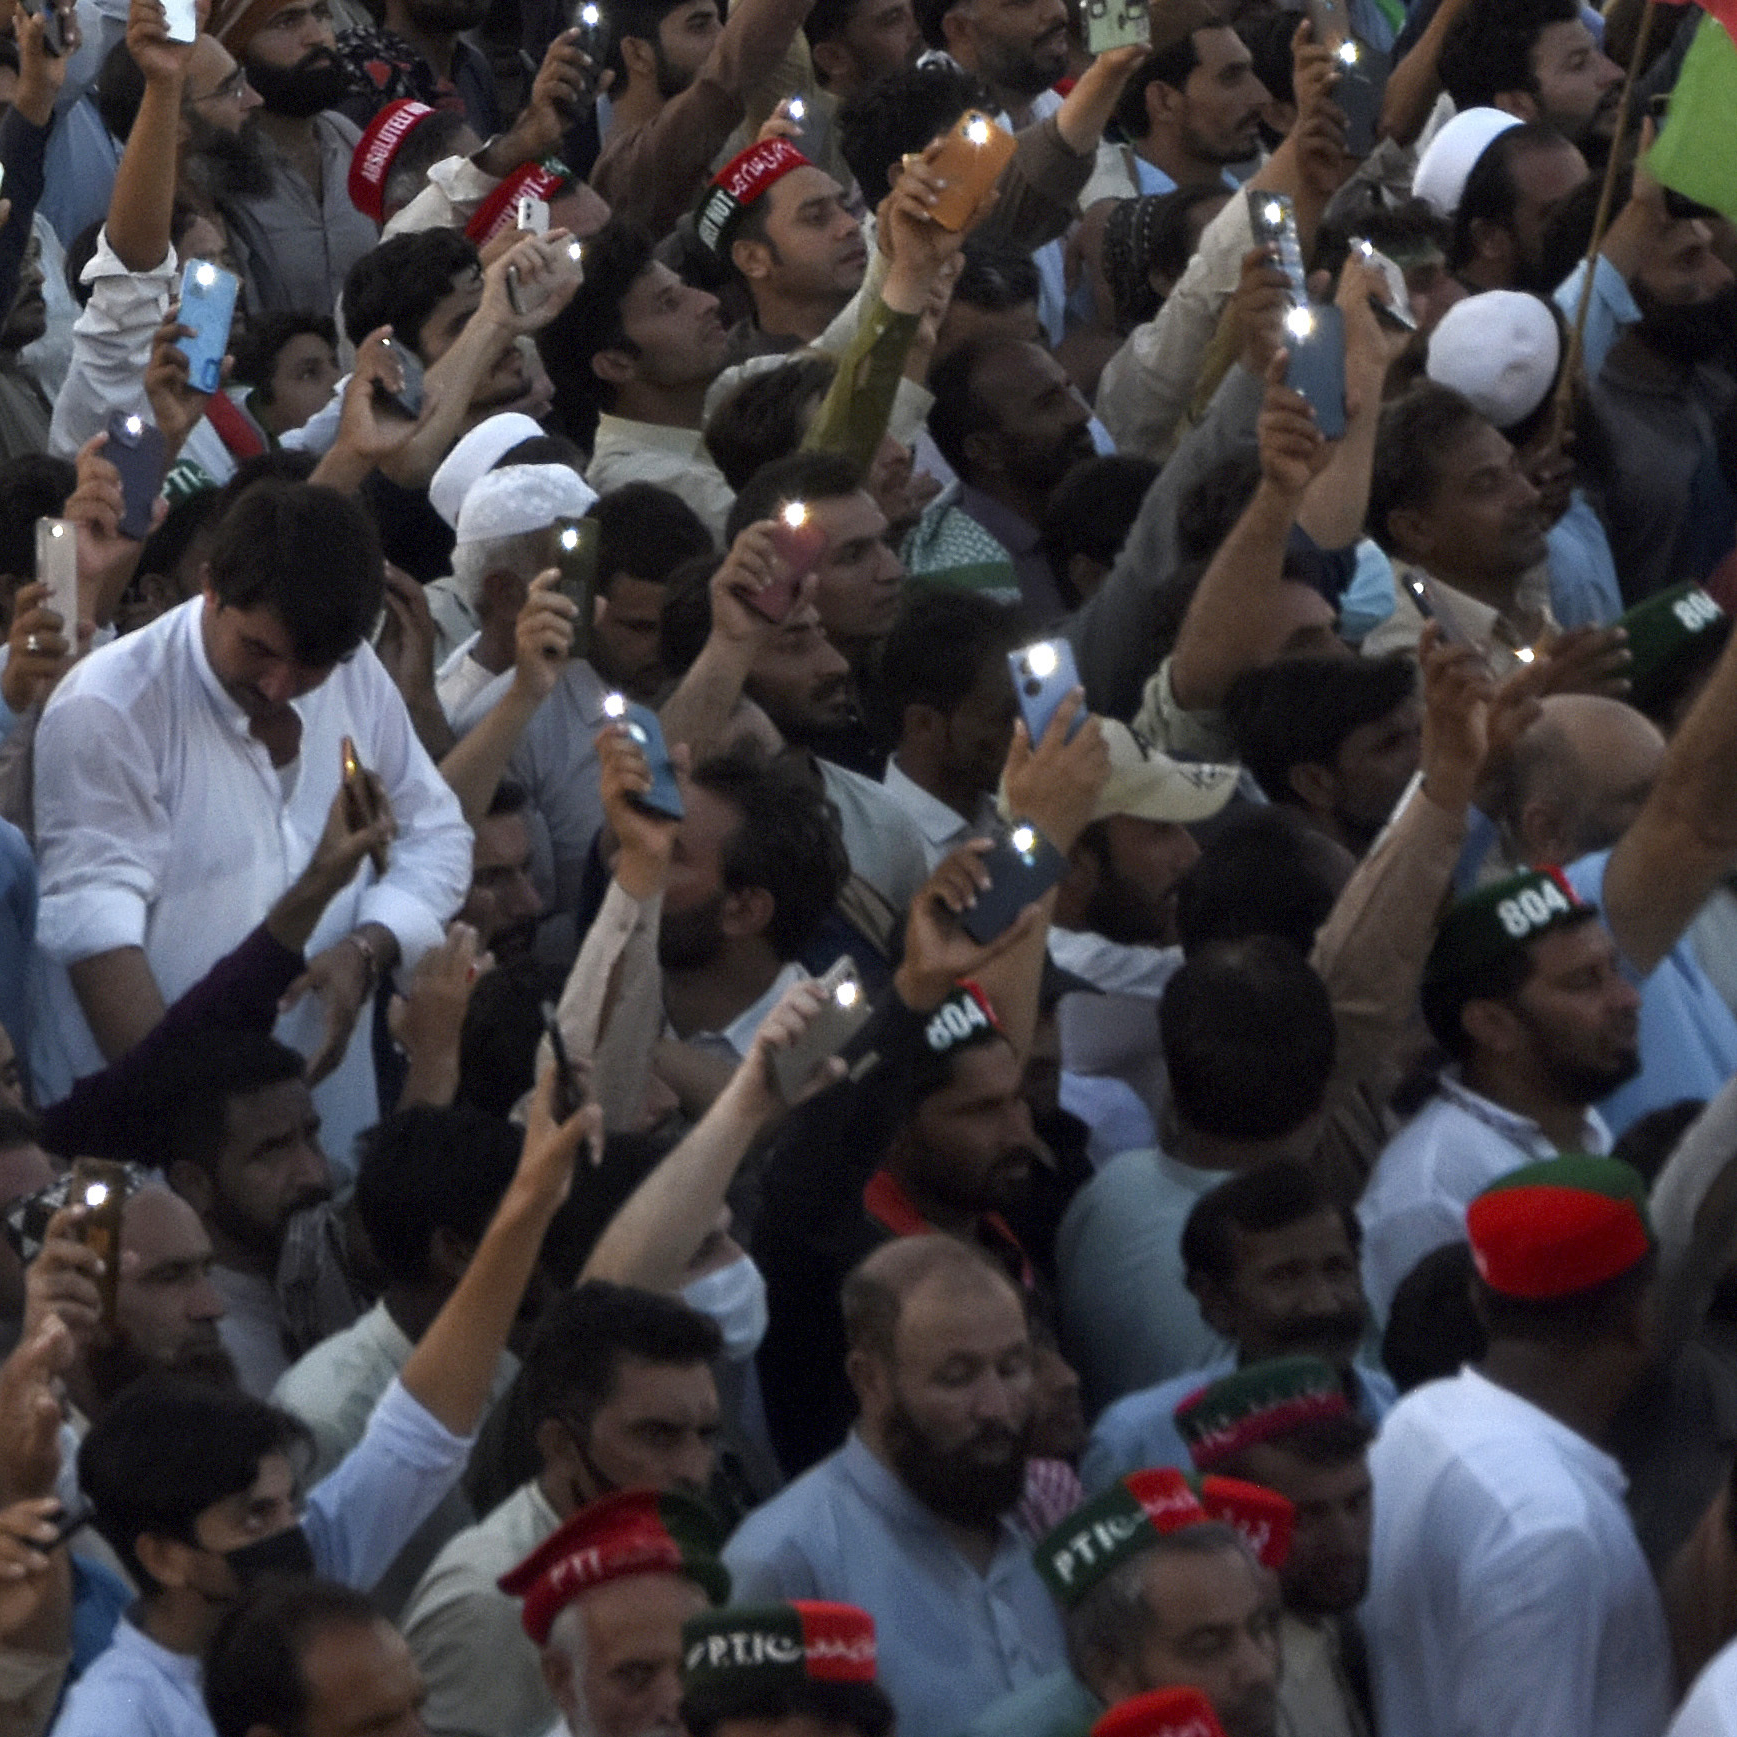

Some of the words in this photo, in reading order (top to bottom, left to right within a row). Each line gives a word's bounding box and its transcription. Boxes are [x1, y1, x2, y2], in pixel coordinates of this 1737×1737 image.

[361, 108, 416, 184] ABSOLUTELY
[1672, 588, 1725, 632] 804
[1498, 879, 1571, 937] 804
[925, 993, 988, 1050] 804
